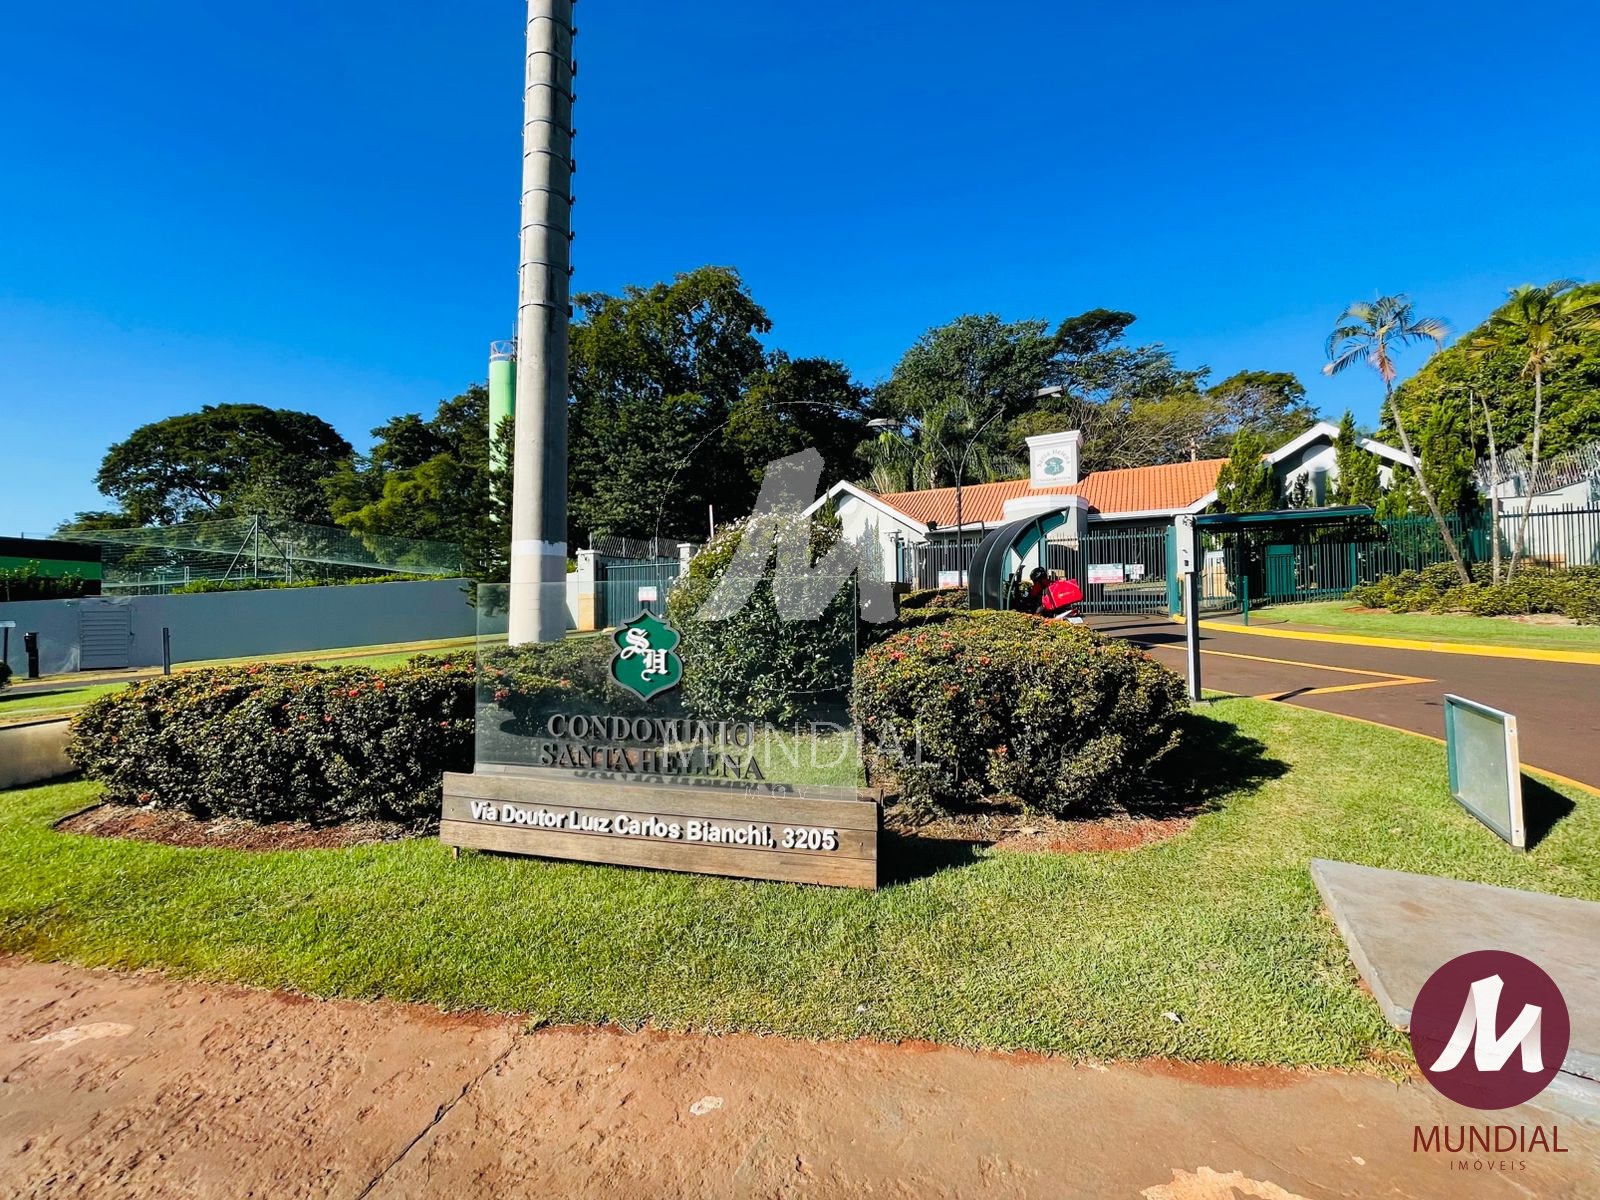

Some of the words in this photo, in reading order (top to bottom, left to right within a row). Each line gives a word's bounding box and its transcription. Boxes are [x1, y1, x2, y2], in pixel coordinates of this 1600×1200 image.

[547, 713, 754, 749] CONDOMÍNIO
[540, 742, 635, 772] SANTA
[638, 748, 765, 780] HELENA
[470, 800, 500, 821] Via
[502, 804, 567, 828] Doutor
[614, 814, 682, 840] Carlos
[687, 820, 776, 848] Bianchi,
[782, 827, 838, 851] 3205
